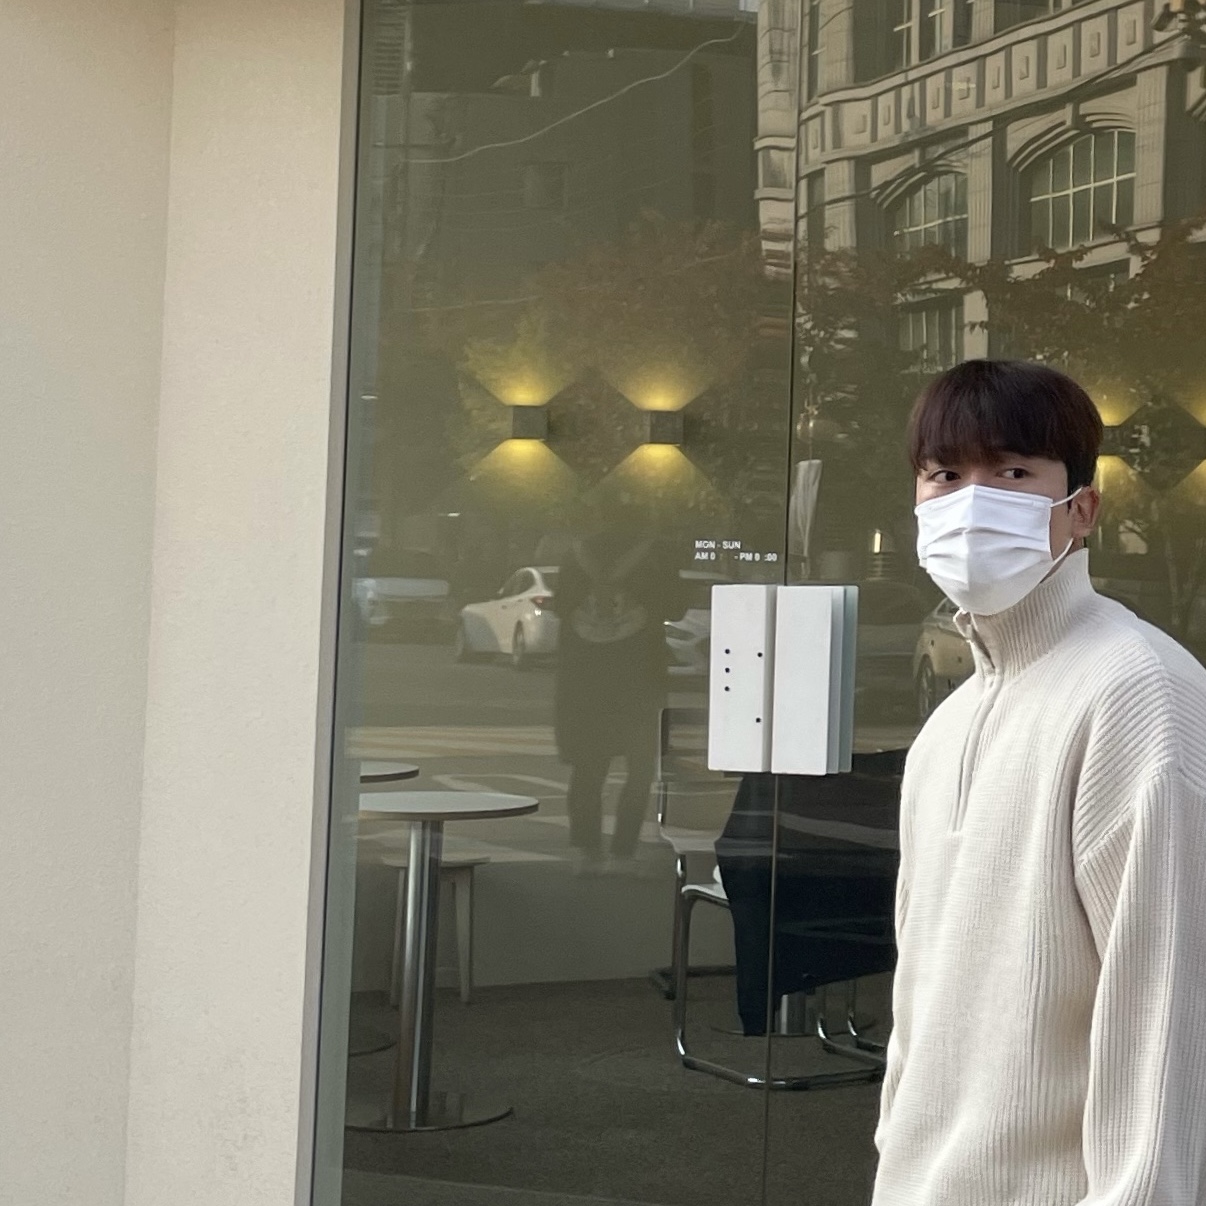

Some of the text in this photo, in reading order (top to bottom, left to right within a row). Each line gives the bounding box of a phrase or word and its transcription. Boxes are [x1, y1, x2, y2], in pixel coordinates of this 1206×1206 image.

[695, 540, 716, 549] MON
[722, 540, 742, 549] SUN
[694, 551, 709, 560] AM
